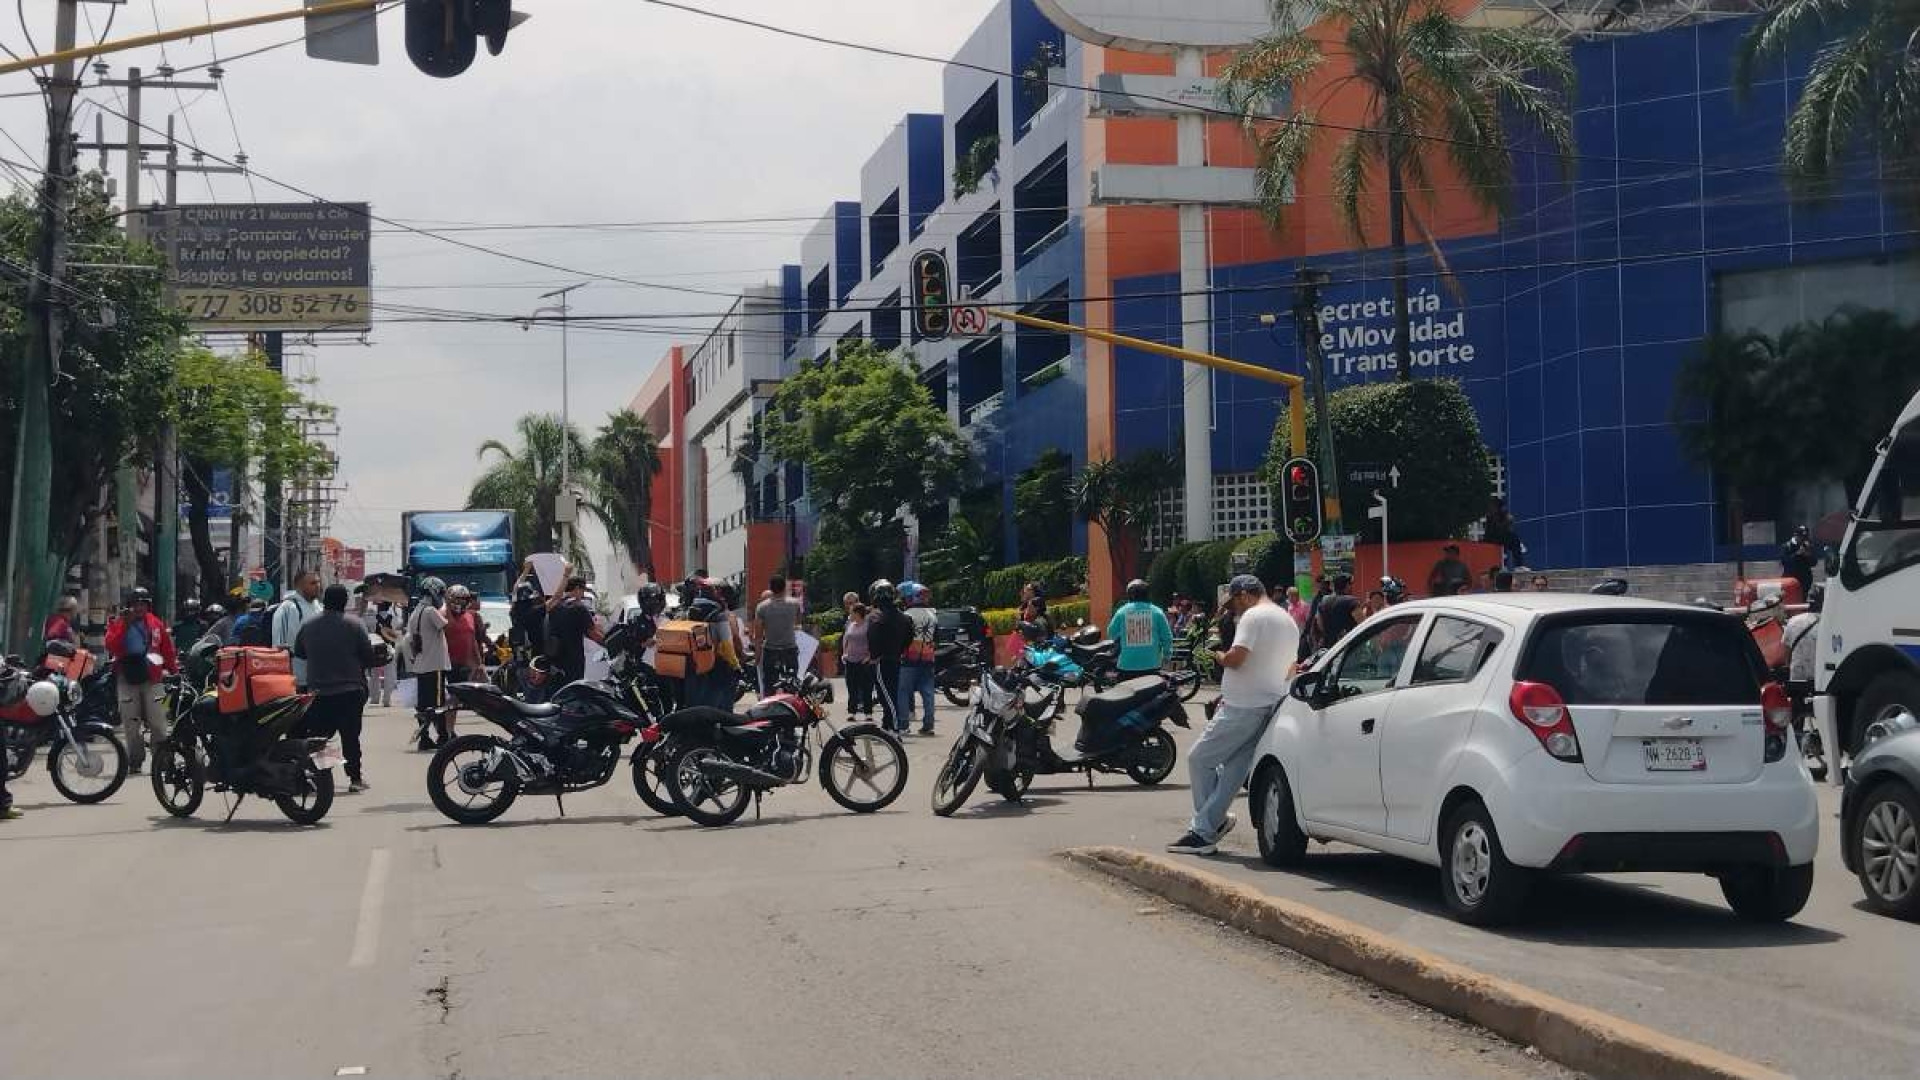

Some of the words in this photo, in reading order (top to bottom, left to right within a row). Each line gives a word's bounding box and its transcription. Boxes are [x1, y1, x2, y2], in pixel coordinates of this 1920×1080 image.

[185, 209, 244, 220] CENTURY
[250, 209, 265, 219] 21
[307, 228, 366, 241] Vender
[237, 248, 252, 261] tu
[256, 247, 351, 264] propiedad?
[243, 268, 257, 282] te
[262, 268, 353, 285] ayudamos!
[185, 294, 230, 315] 777
[239, 294, 282, 315] 308
[292, 294, 321, 314] 52
[330, 294, 358, 313] 76
[1322, 287, 1441, 323] ecretría
[1338, 312, 1465, 350] Movidad
